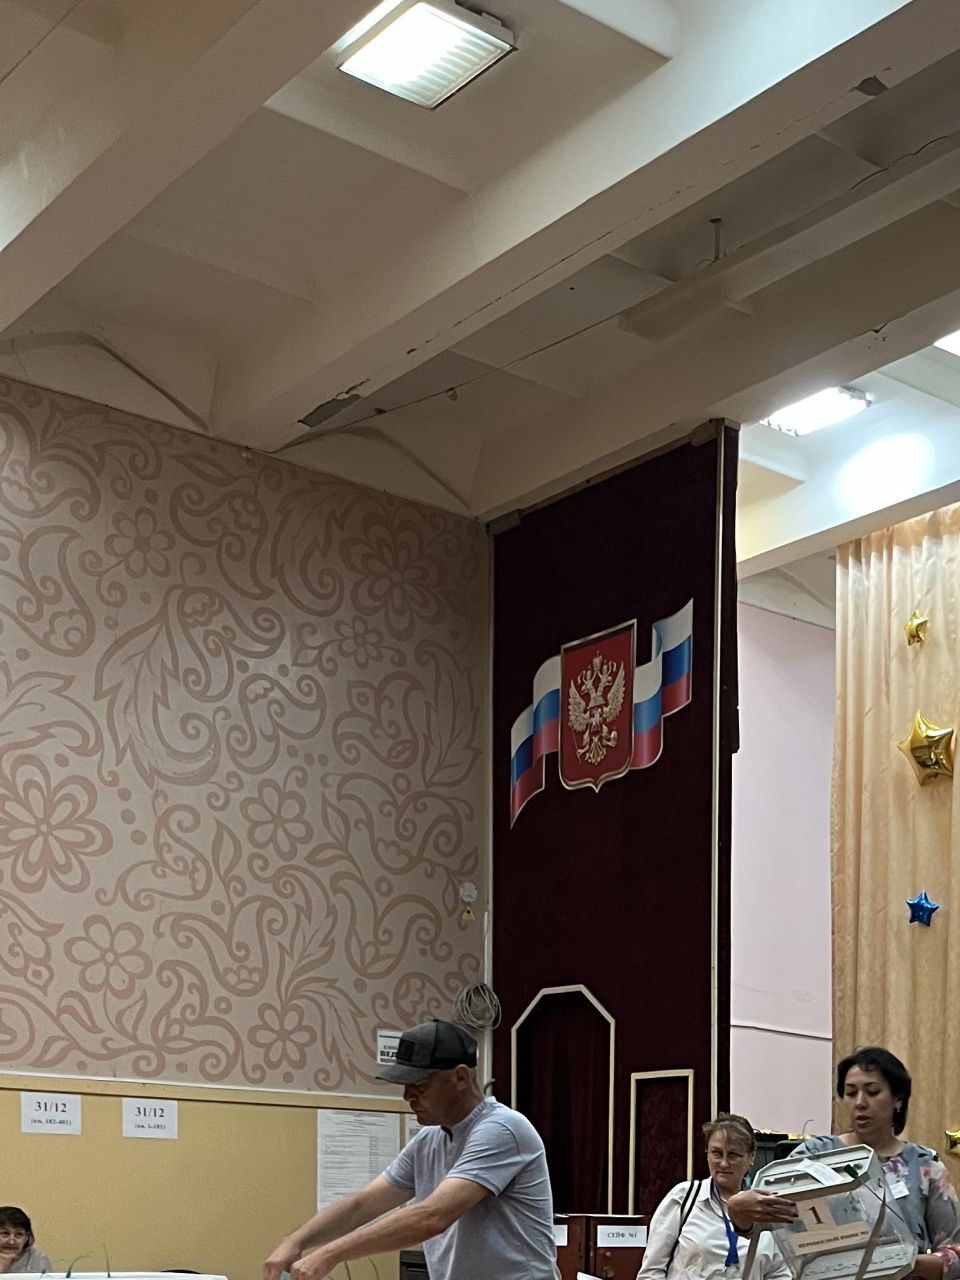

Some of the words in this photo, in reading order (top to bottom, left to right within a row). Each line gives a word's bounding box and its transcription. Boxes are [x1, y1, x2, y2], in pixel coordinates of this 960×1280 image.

[35, 1101, 67, 1113] 31/12
[135, 1107, 165, 1118] 31/12
[808, 1206, 824, 1225] 1
